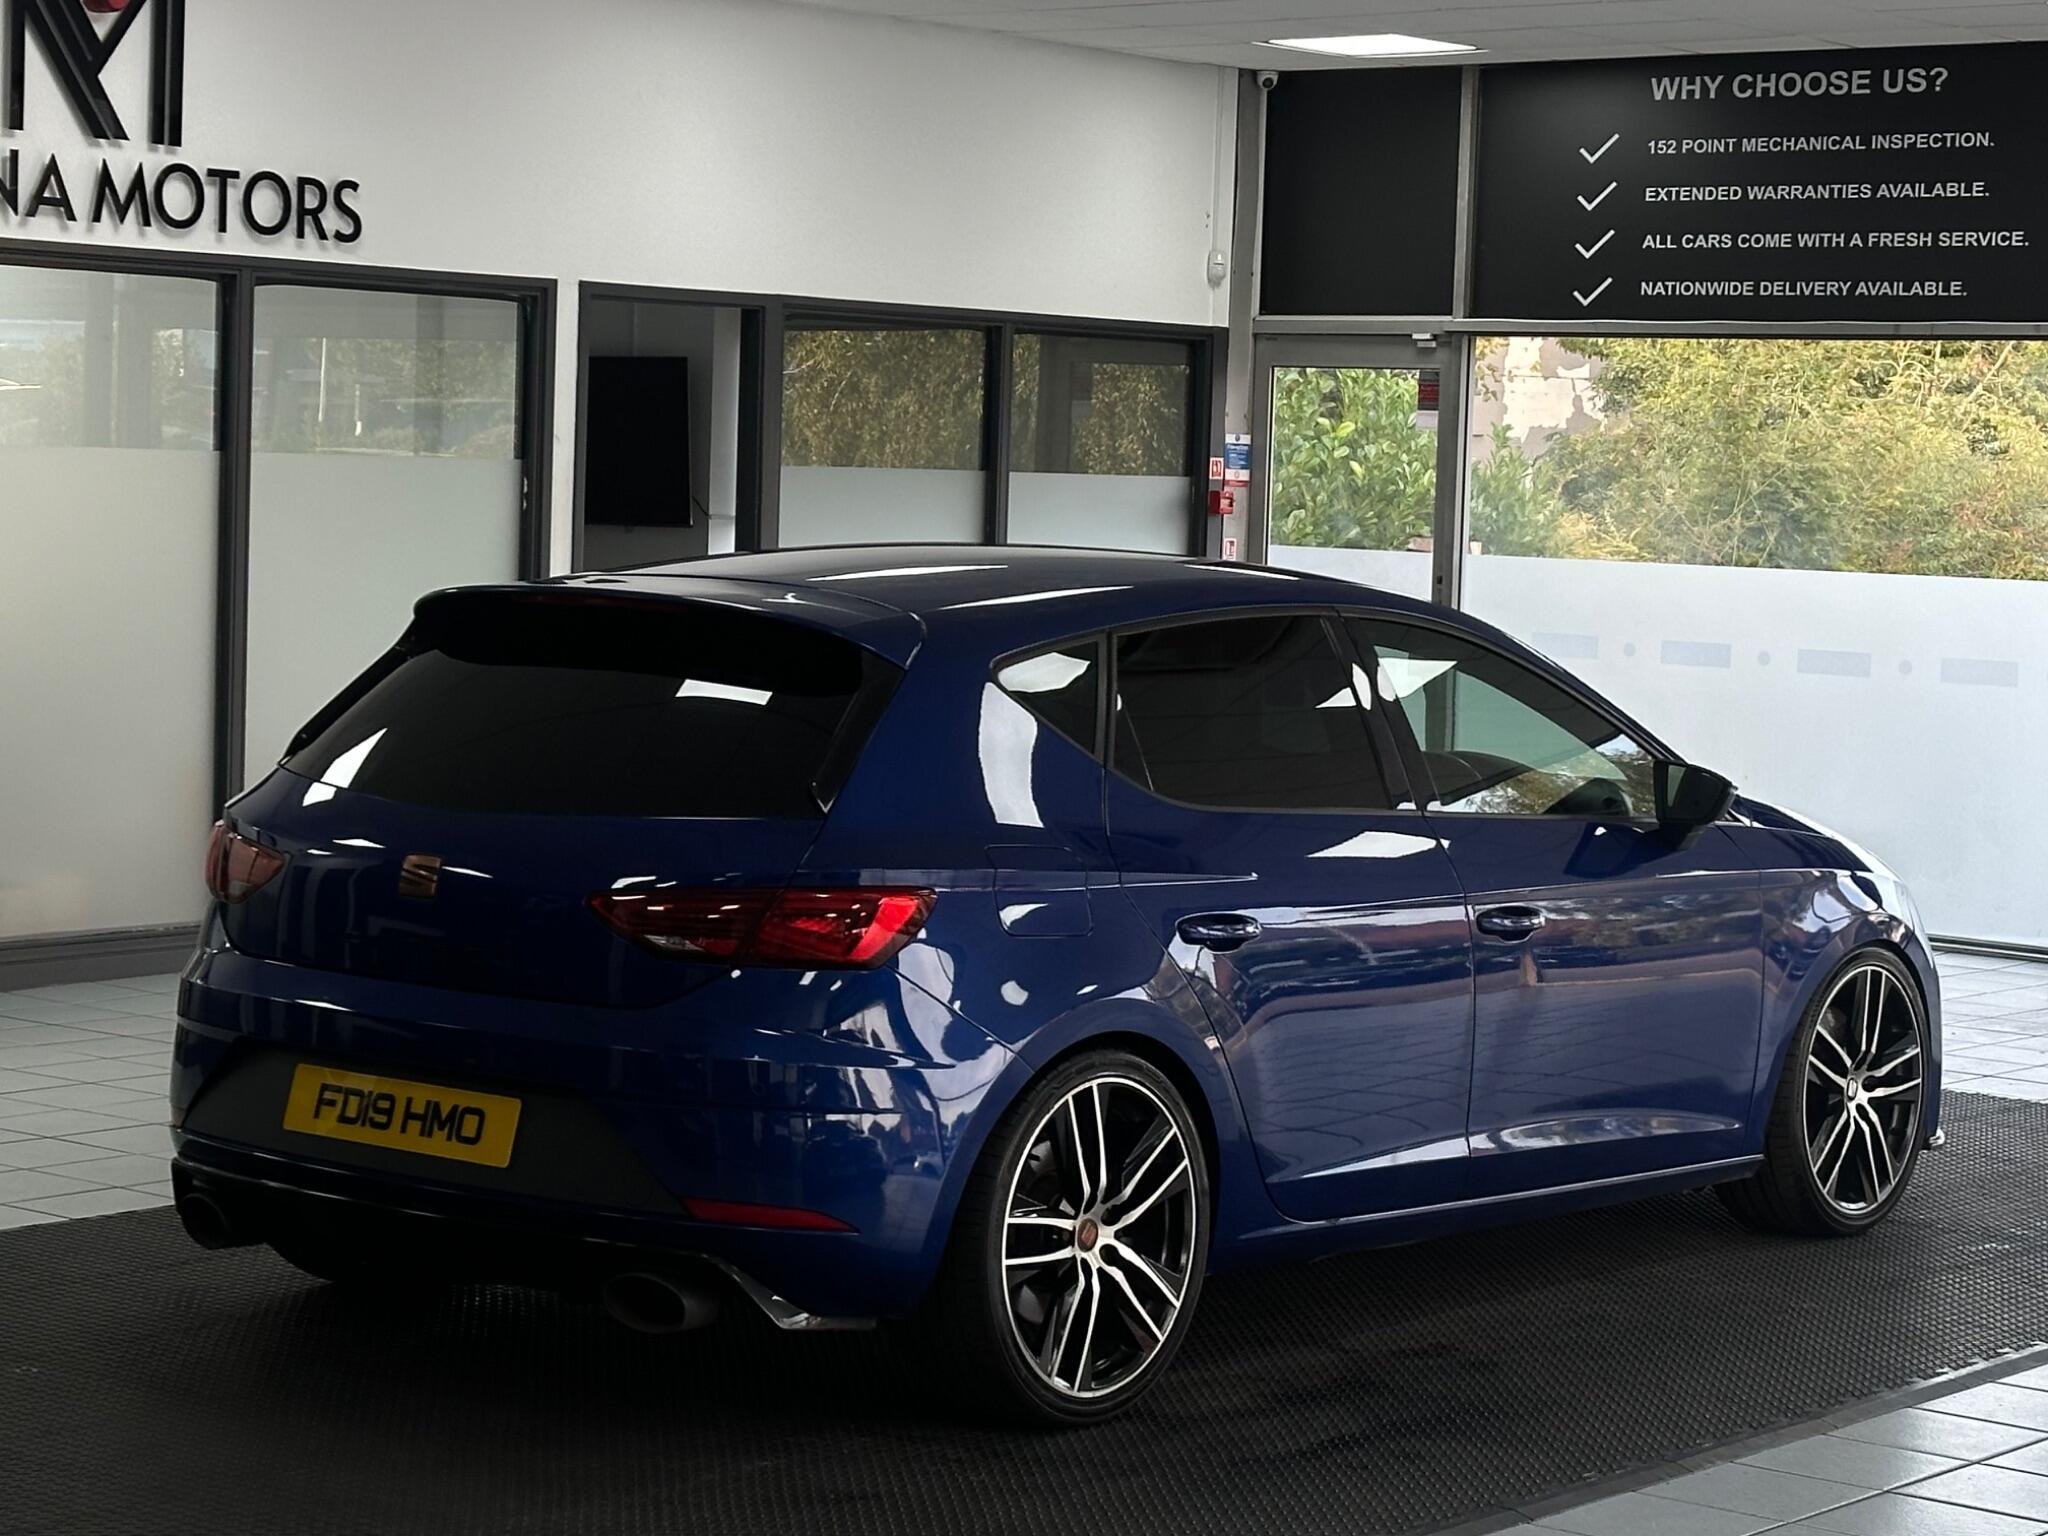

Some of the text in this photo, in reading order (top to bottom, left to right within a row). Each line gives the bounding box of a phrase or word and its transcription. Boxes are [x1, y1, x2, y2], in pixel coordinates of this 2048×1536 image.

[1651, 68, 1947, 100] WHY CHOOSE US?
[1648, 132, 1994, 154] 152 POINT MECHANICAL INSPECTION.
[92, 159, 361, 243] MOTORS
[1645, 182, 1989, 201] EXTENDED WARRANTIES AVAILABLE.
[1642, 231, 2029, 248] ALL CARS COME WITH A FRESH SERVICE.
[1641, 281, 1967, 296] NATIONWIDE DELIVERY AVAILABLE.
[314, 1083, 485, 1145] FD19 HMO
